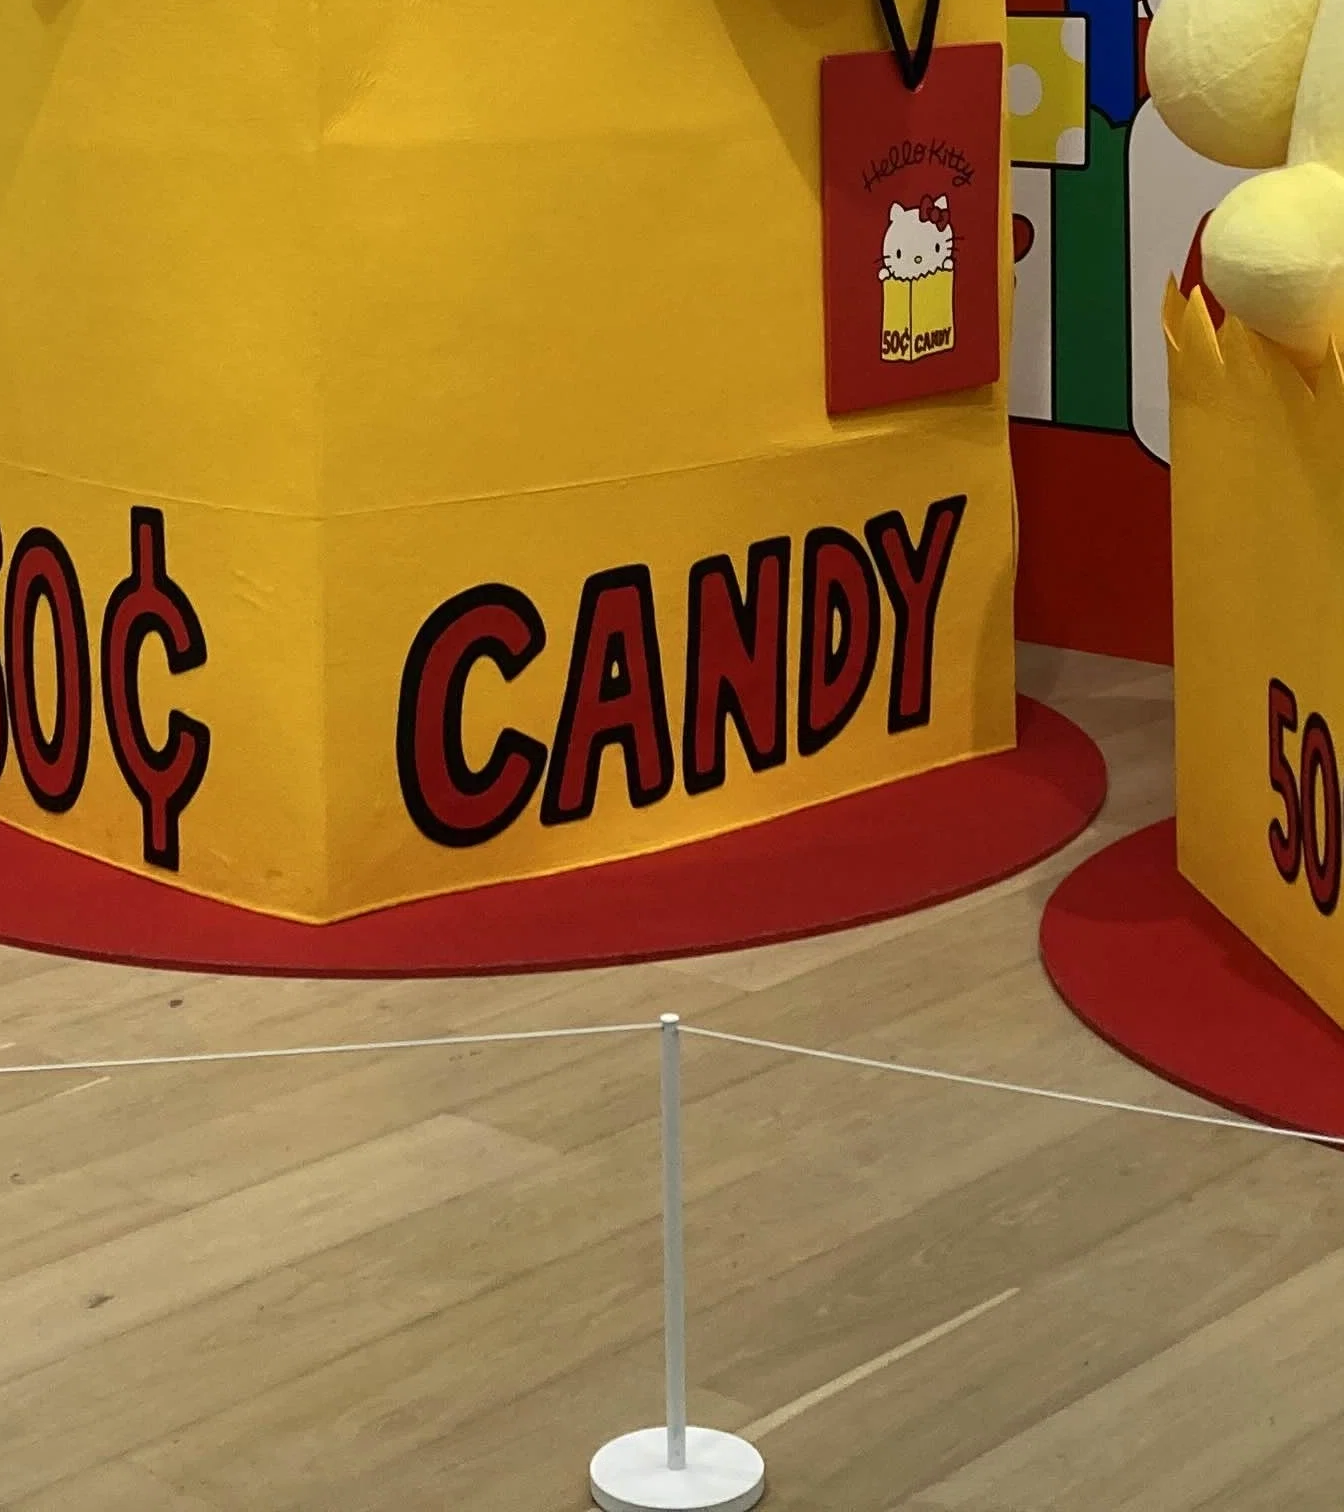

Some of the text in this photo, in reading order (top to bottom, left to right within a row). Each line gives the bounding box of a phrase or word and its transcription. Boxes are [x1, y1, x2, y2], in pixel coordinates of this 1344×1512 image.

[863, 137, 975, 192] Hello Kitty
[396, 494, 968, 849] CANDY
